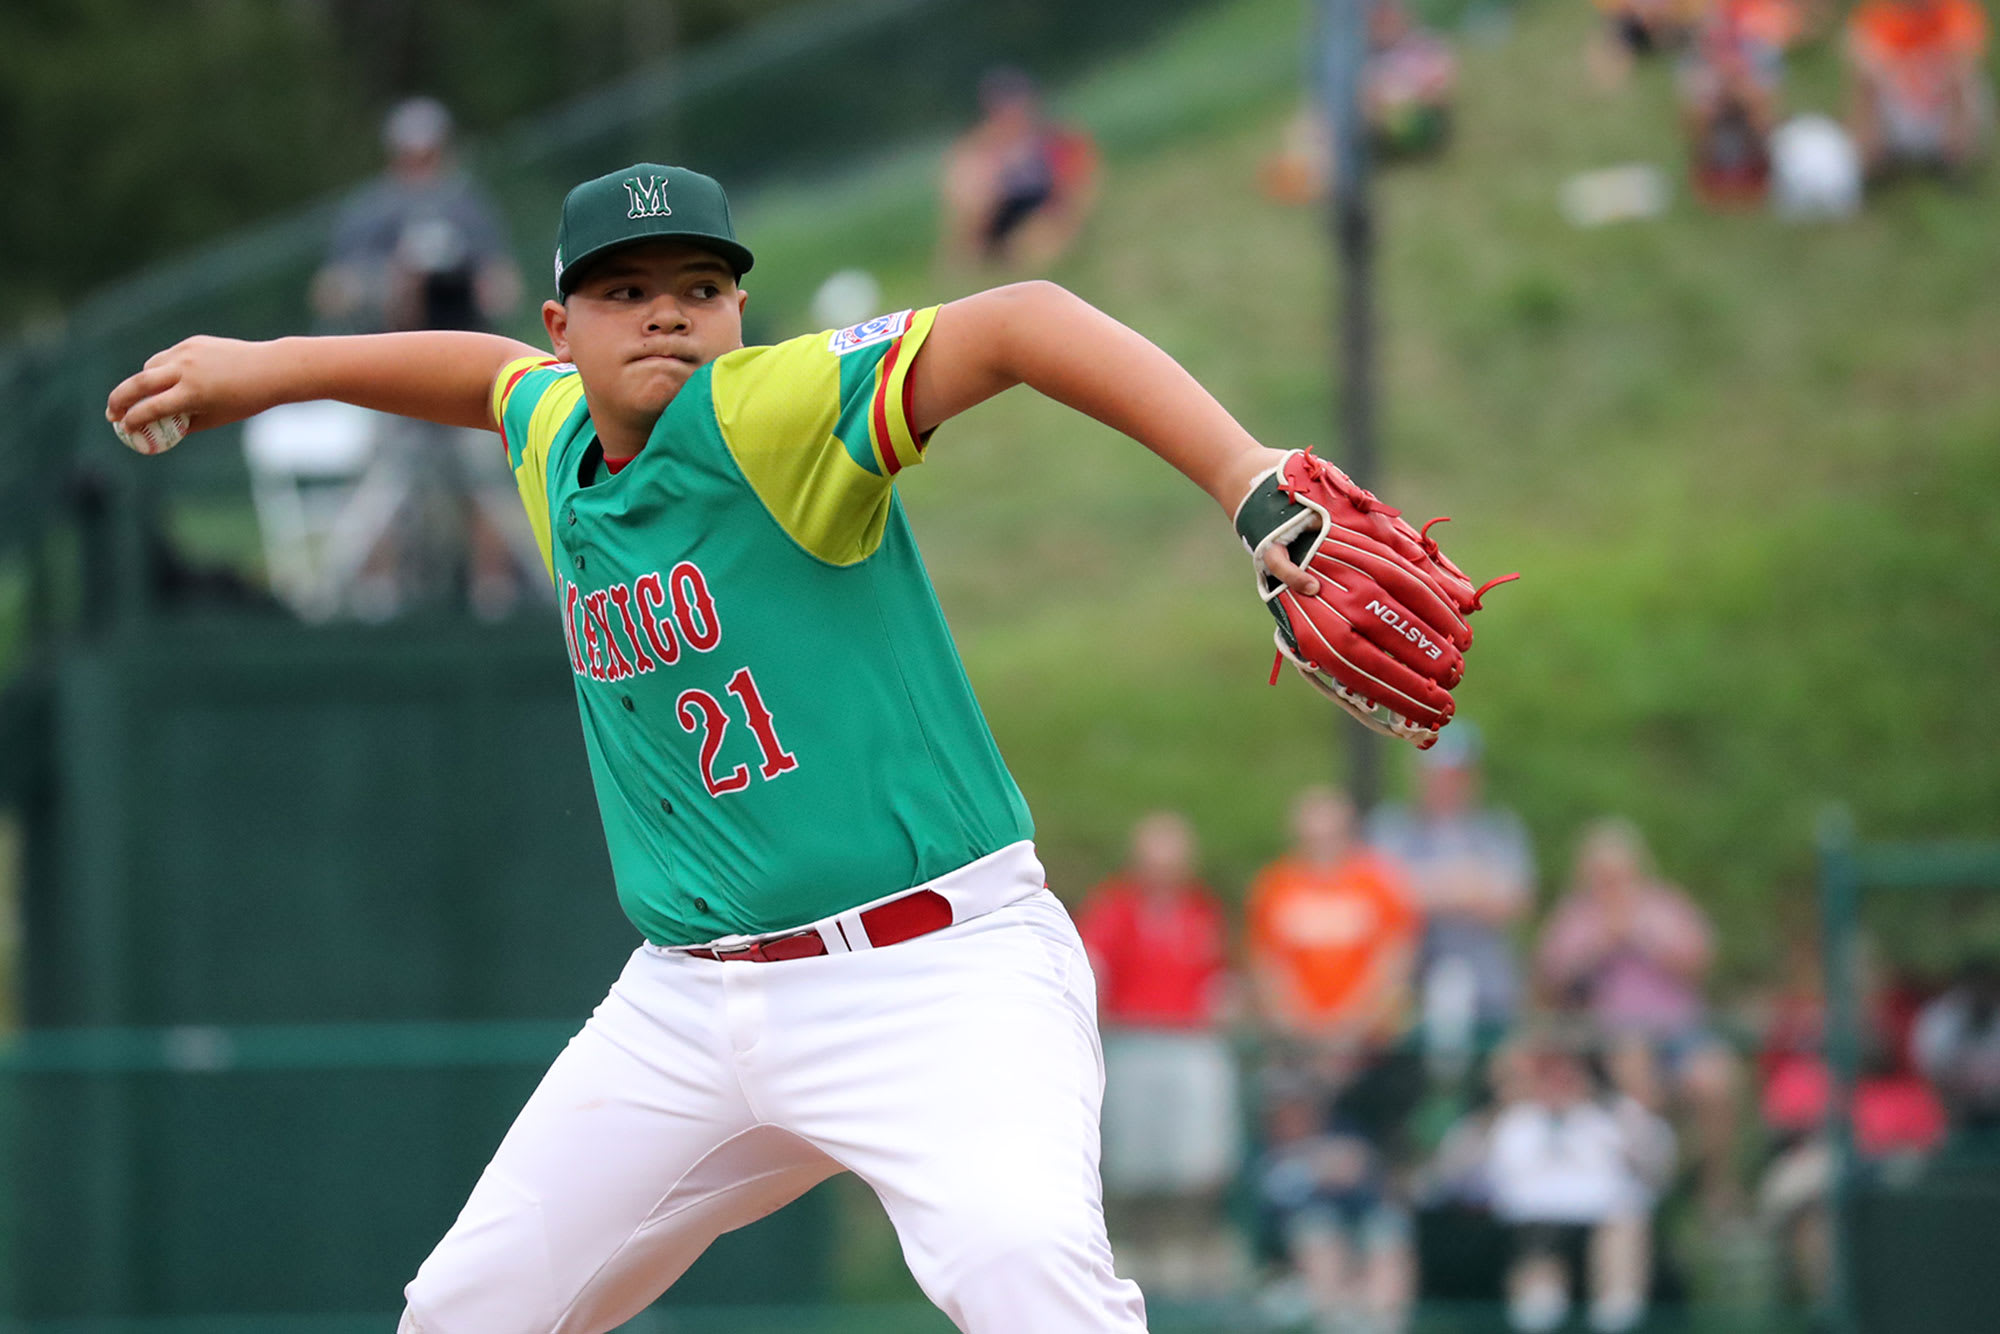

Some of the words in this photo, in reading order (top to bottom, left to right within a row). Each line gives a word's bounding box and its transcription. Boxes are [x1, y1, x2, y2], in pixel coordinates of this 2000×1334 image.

[623, 175, 672, 219] M
[558, 560, 722, 683] MEXICO
[1364, 599, 1443, 660] EASTON
[675, 665, 800, 799] 21
